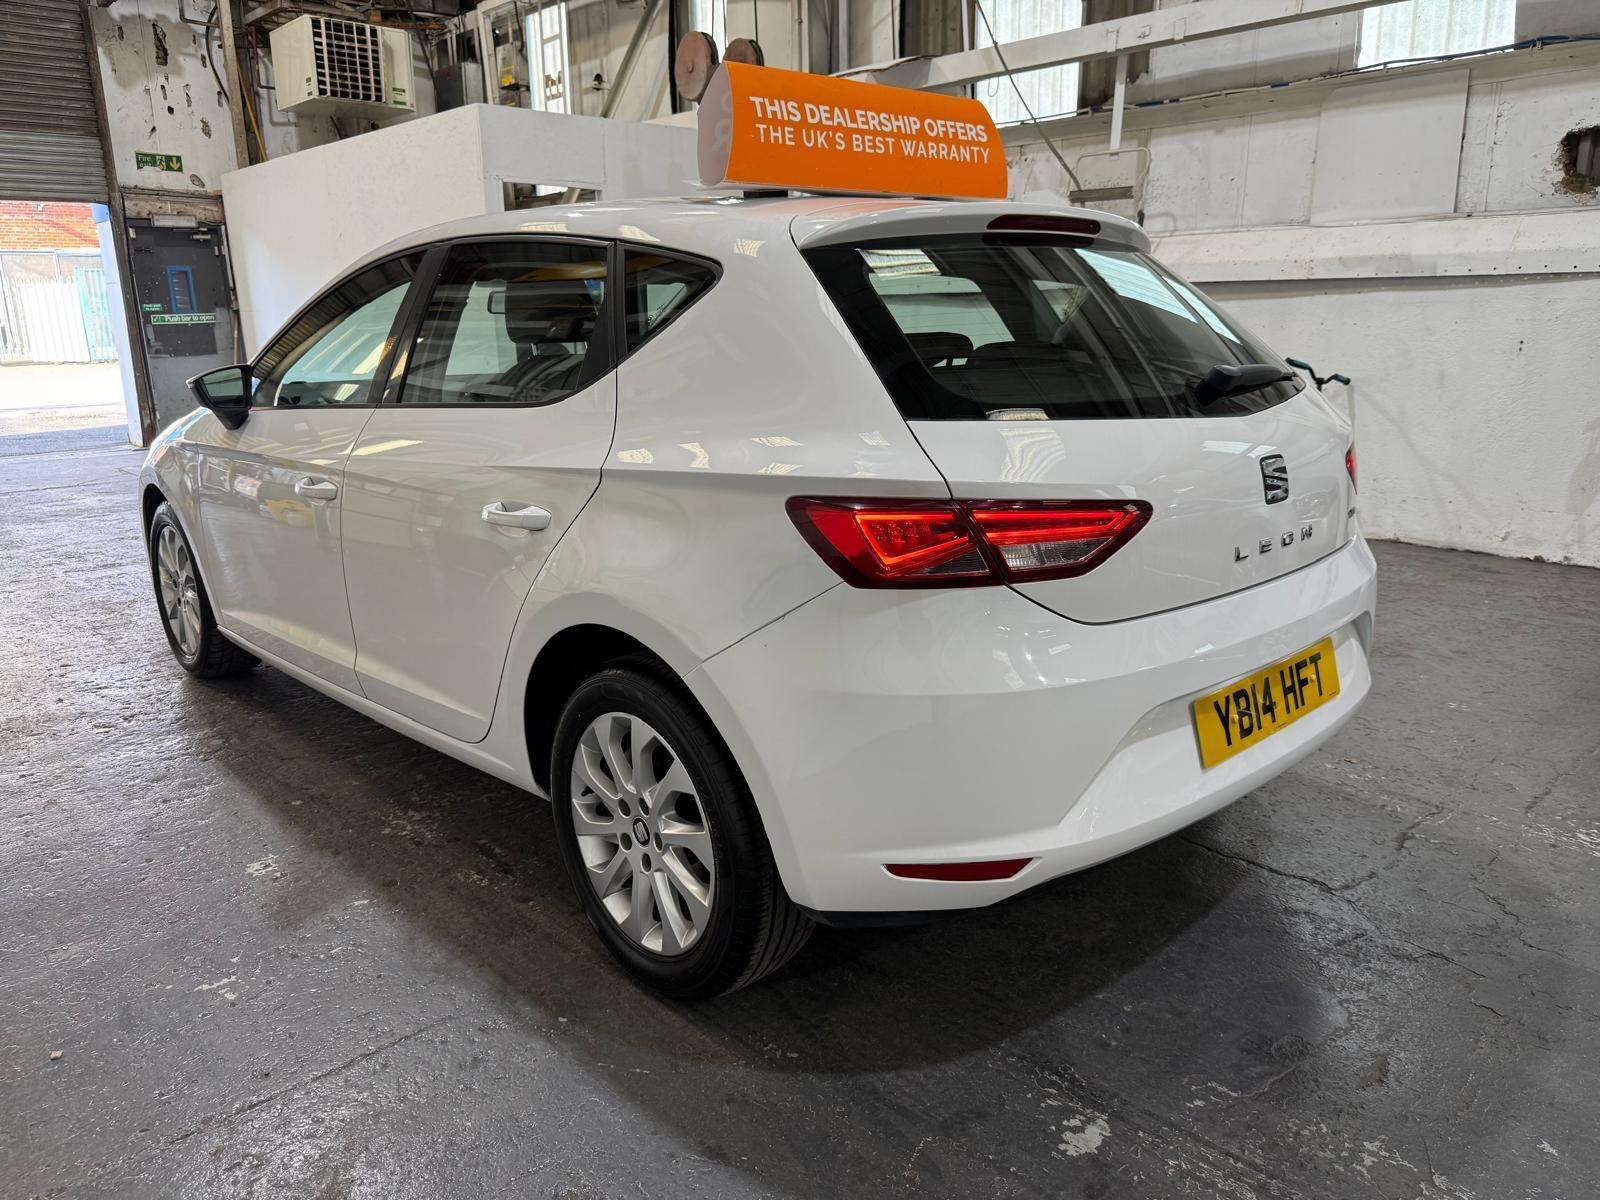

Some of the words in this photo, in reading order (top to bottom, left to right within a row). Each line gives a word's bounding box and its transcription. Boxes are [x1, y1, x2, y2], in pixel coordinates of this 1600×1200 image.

[748, 95, 802, 122] THIS
[804, 103, 921, 135] DEALERSHIP
[924, 118, 989, 142] OFFERS
[755, 123, 796, 146] THE
[802, 128, 846, 150] UK'S
[852, 134, 896, 155] BEST
[900, 138, 990, 164] WARRANTY
[1234, 524, 1313, 562] LEON
[1213, 676, 1277, 746] YB14
[1279, 651, 1322, 714] HFT
